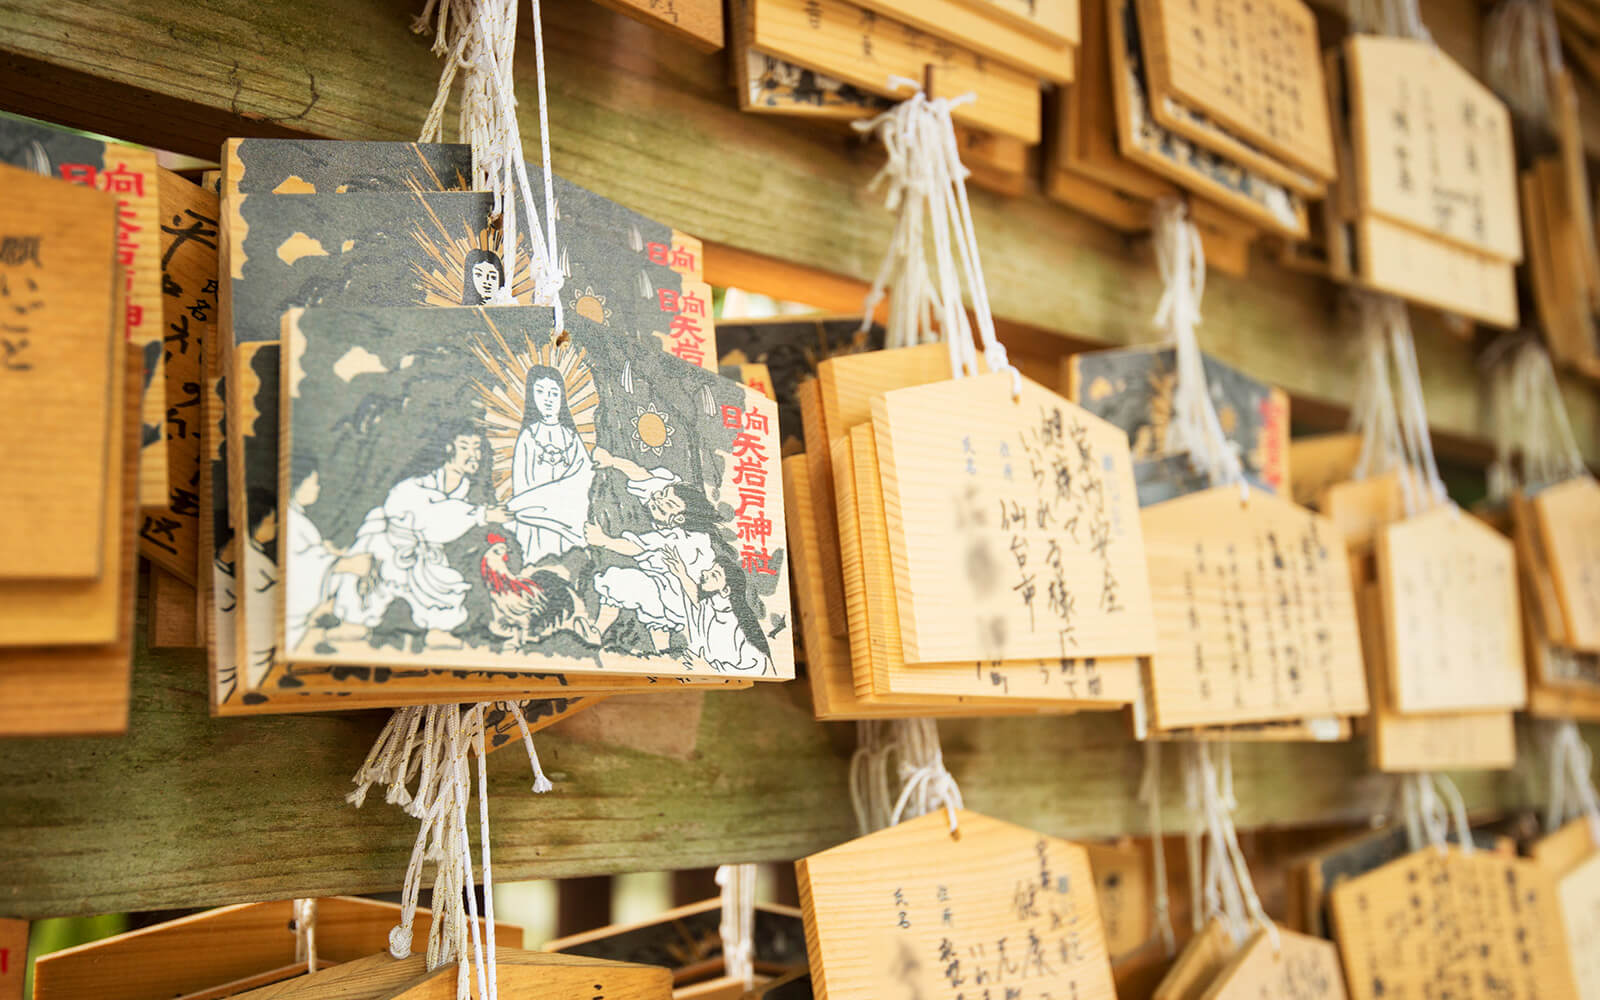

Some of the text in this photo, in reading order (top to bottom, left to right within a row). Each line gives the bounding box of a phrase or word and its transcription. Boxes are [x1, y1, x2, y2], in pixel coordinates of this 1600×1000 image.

[732, 432, 777, 575] 天岩戸神社
